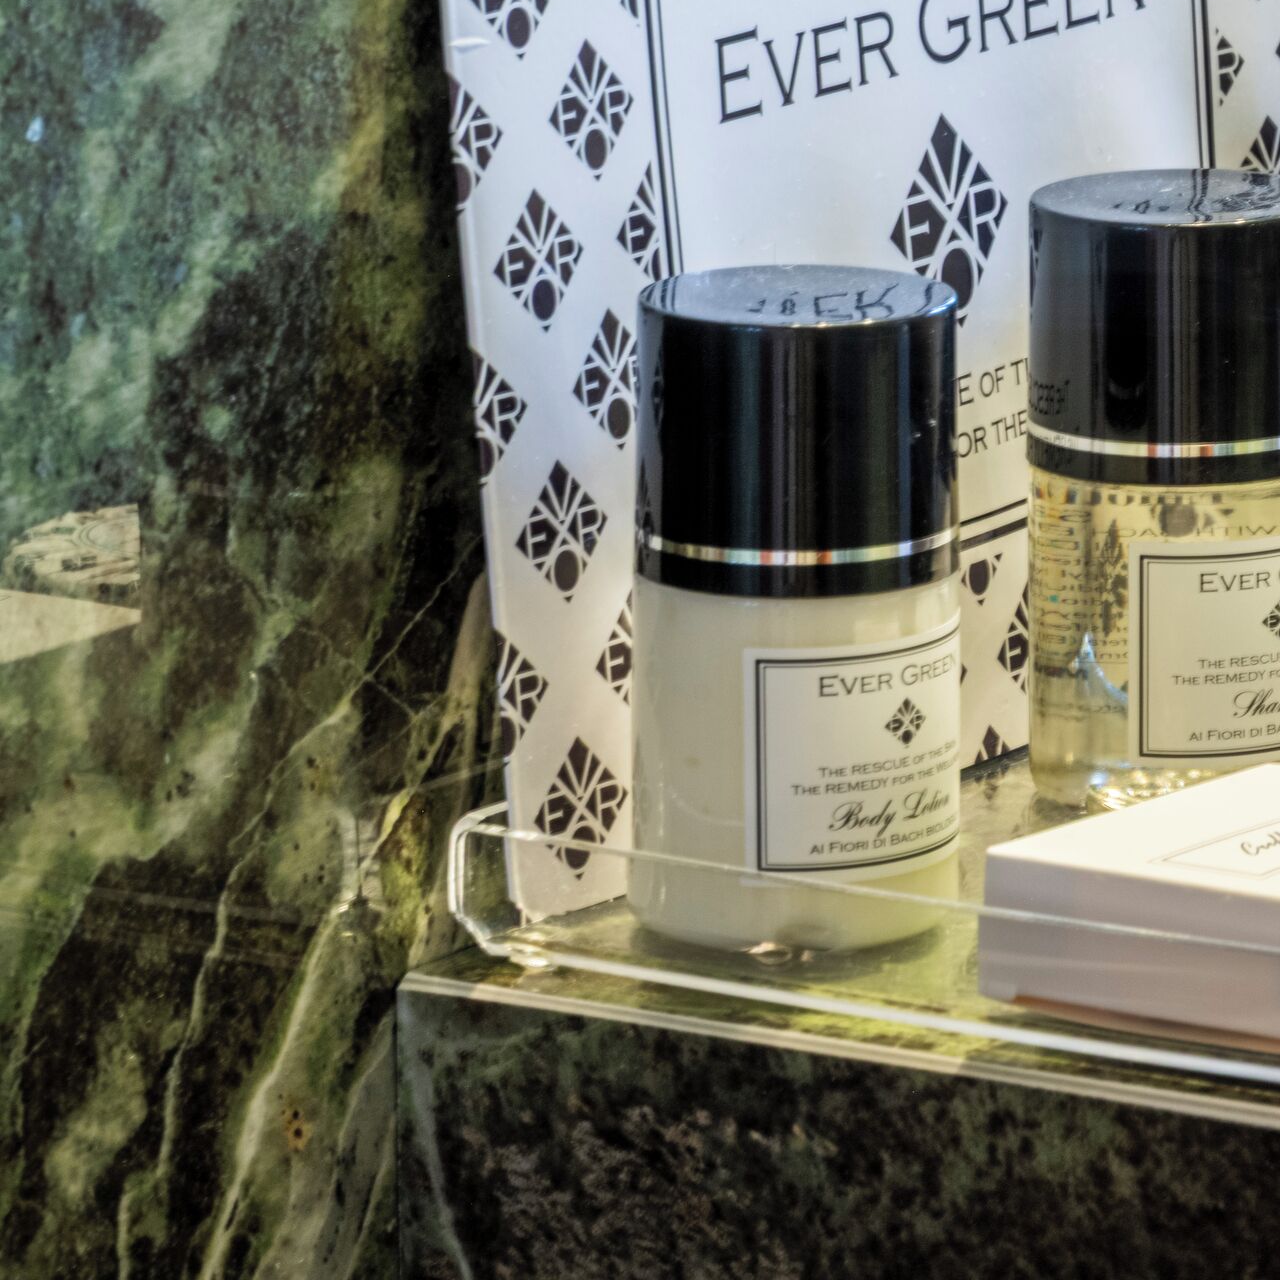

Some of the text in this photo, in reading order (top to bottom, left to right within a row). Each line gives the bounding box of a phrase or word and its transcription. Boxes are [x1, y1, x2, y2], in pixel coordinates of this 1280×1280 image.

[714, 11, 898, 123] EVER
[980, 365, 1006, 398] OF
[956, 426, 988, 458] OR
[1199, 571, 1271, 593] EVER
[1198, 658, 1225, 669] THE
[818, 674, 893, 698] EVER
[1172, 675, 1201, 686] THE
[1204, 669, 1267, 685] REMEDY
[1208, 729, 1245, 741] FIORI
[1250, 728, 1263, 738] DI
[818, 766, 847, 779] THE
[851, 756, 909, 778] RESCUE
[913, 753, 925, 765] OF
[791, 785, 821, 797] THE
[825, 774, 888, 794] REMEDY
[892, 770, 914, 786] FOR
[828, 788, 950, 838] Body Lotion
[829, 841, 869, 854] FIORI
[873, 837, 886, 848] DI
[891, 829, 924, 845] BACH
